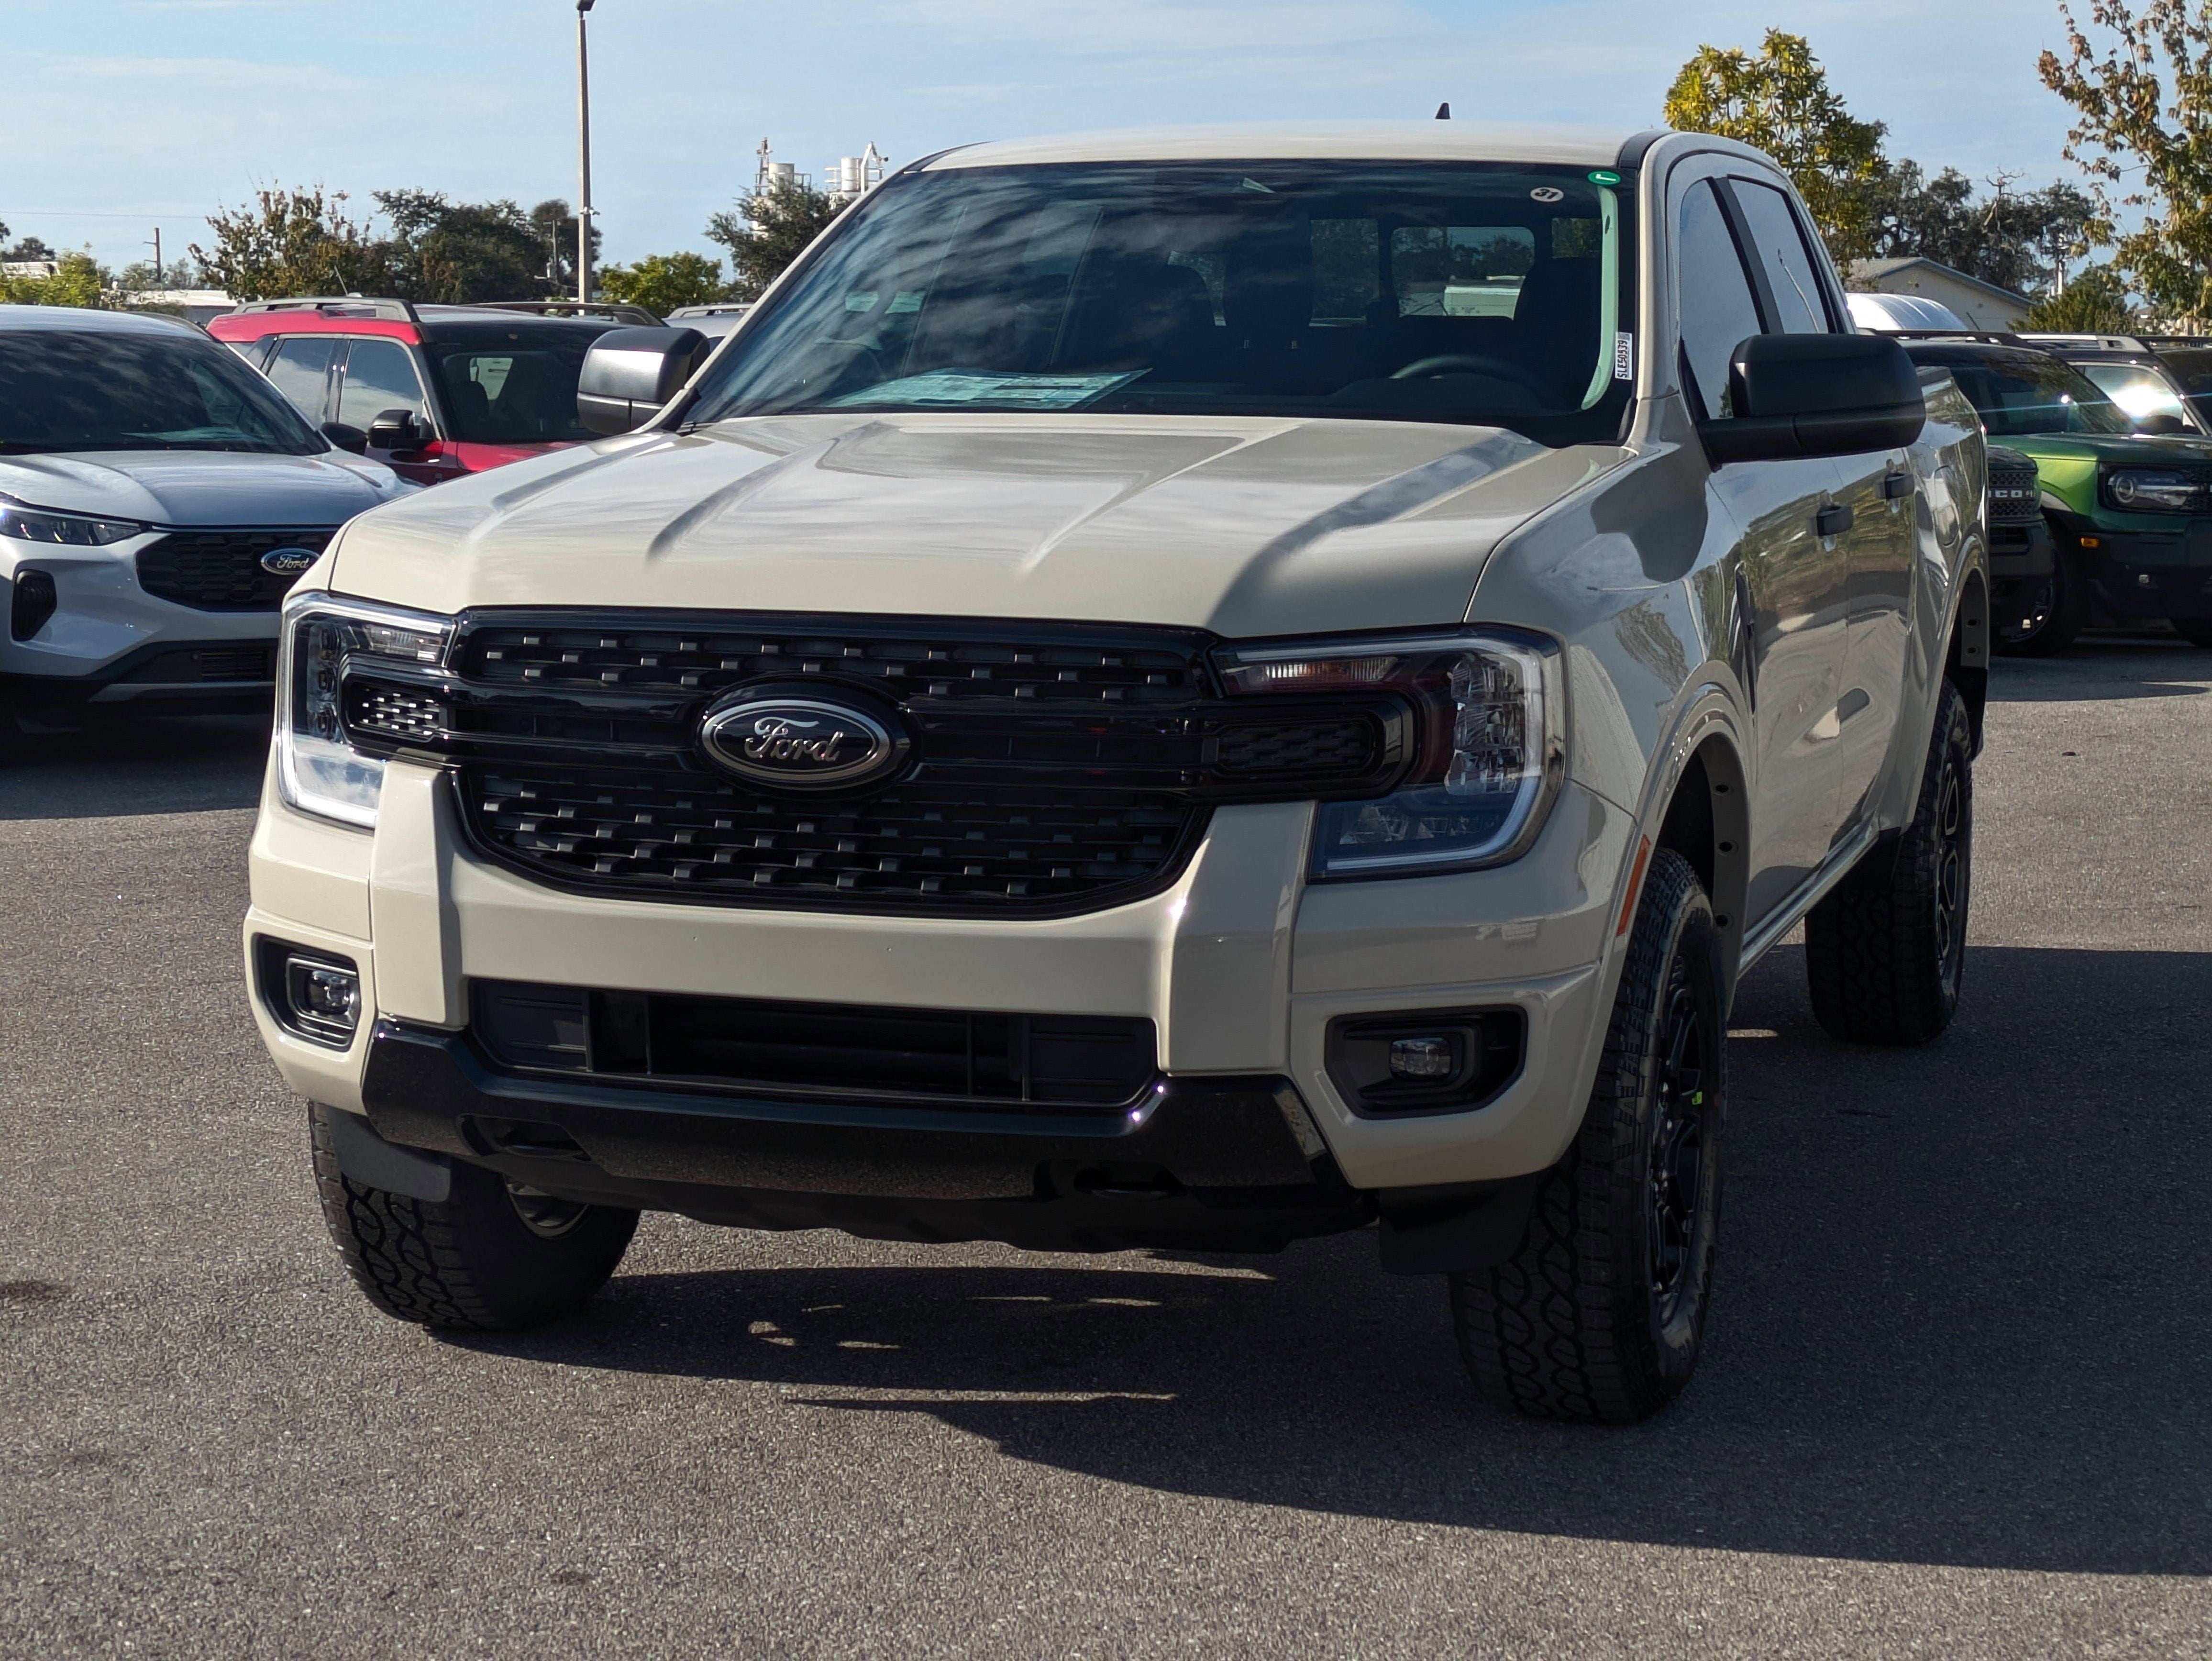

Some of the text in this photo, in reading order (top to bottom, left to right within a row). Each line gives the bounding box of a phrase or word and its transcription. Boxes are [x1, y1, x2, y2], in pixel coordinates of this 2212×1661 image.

[1535, 188, 1559, 199] 31
[276, 554, 310, 569] Ford
[744, 716, 844, 762] Ford
